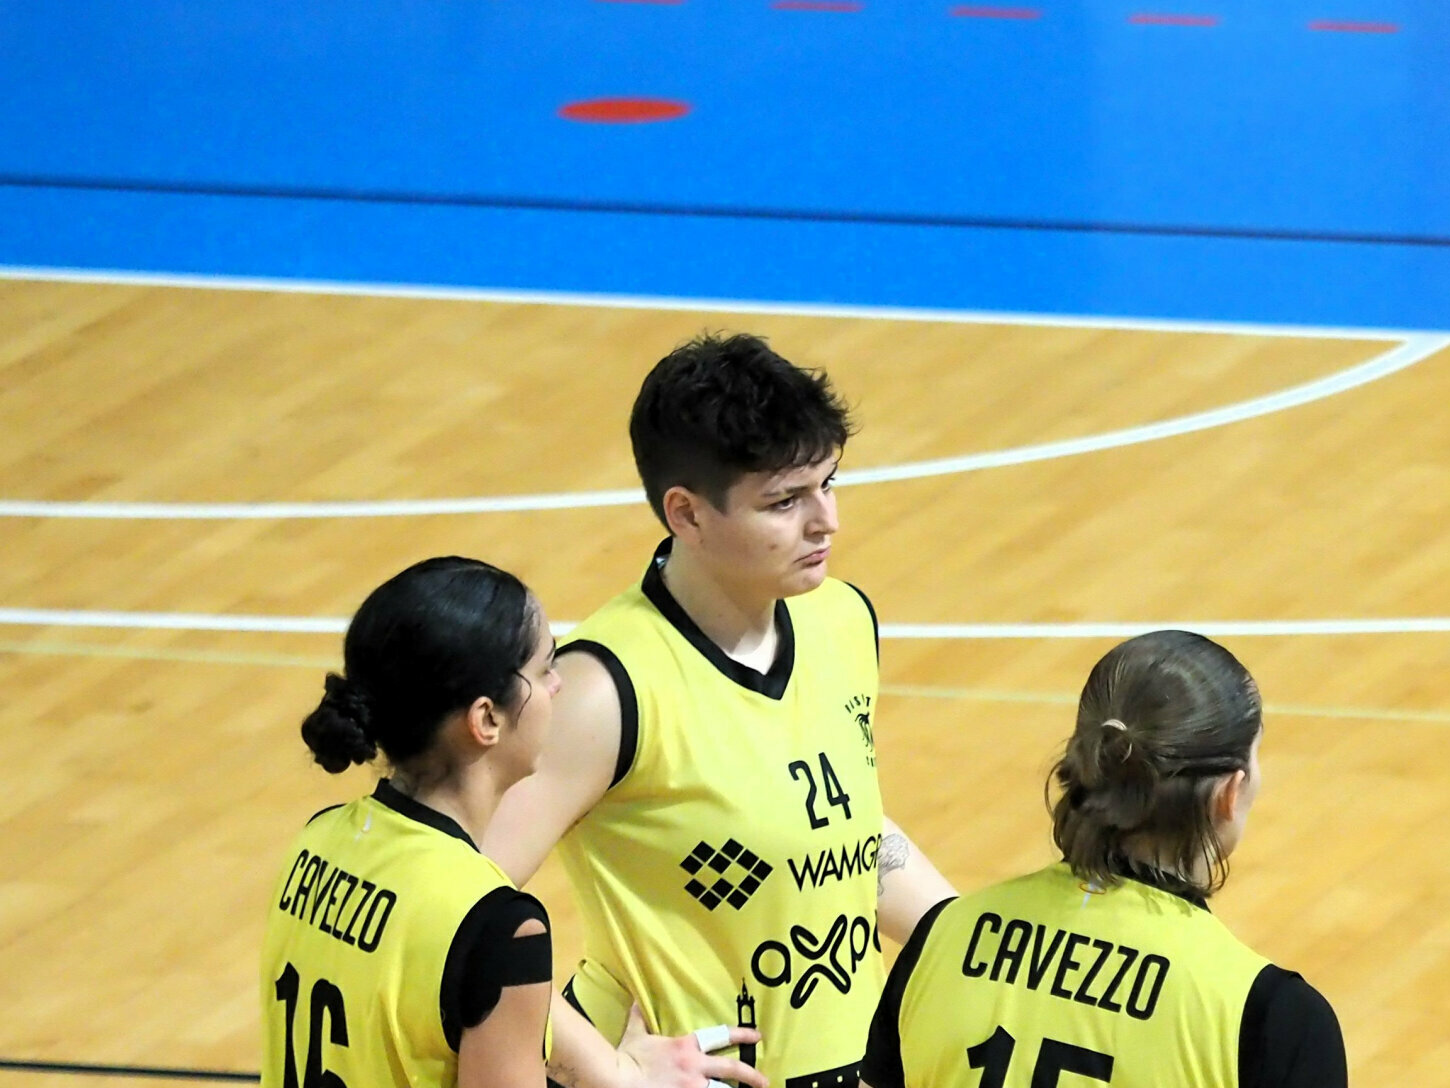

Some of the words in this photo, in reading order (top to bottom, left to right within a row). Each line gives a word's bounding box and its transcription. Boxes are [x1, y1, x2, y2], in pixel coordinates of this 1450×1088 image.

[788, 752, 852, 830] 24
[278, 849, 397, 953] CAVEZZO
[961, 911, 1171, 1021] CAVEZZO
